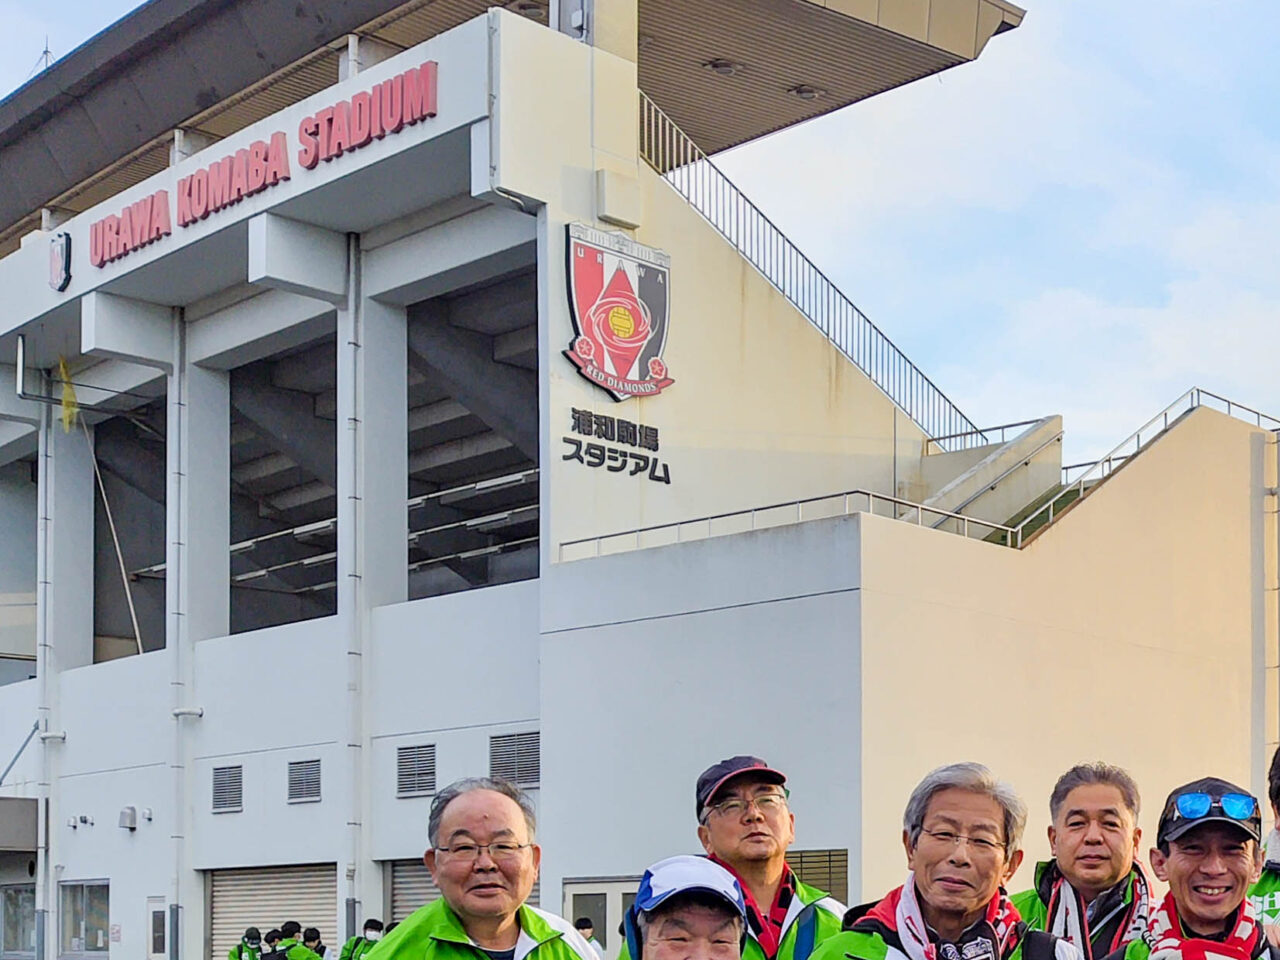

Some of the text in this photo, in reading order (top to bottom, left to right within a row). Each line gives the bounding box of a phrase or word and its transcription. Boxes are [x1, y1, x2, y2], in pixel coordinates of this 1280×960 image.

[90, 60, 438, 269] URAWA KOMABA STADIUM
[586, 365, 657, 394] RED DIAMONDS
[571, 407, 660, 452] 浦和駒場
[562, 437, 671, 485] スタジアム
